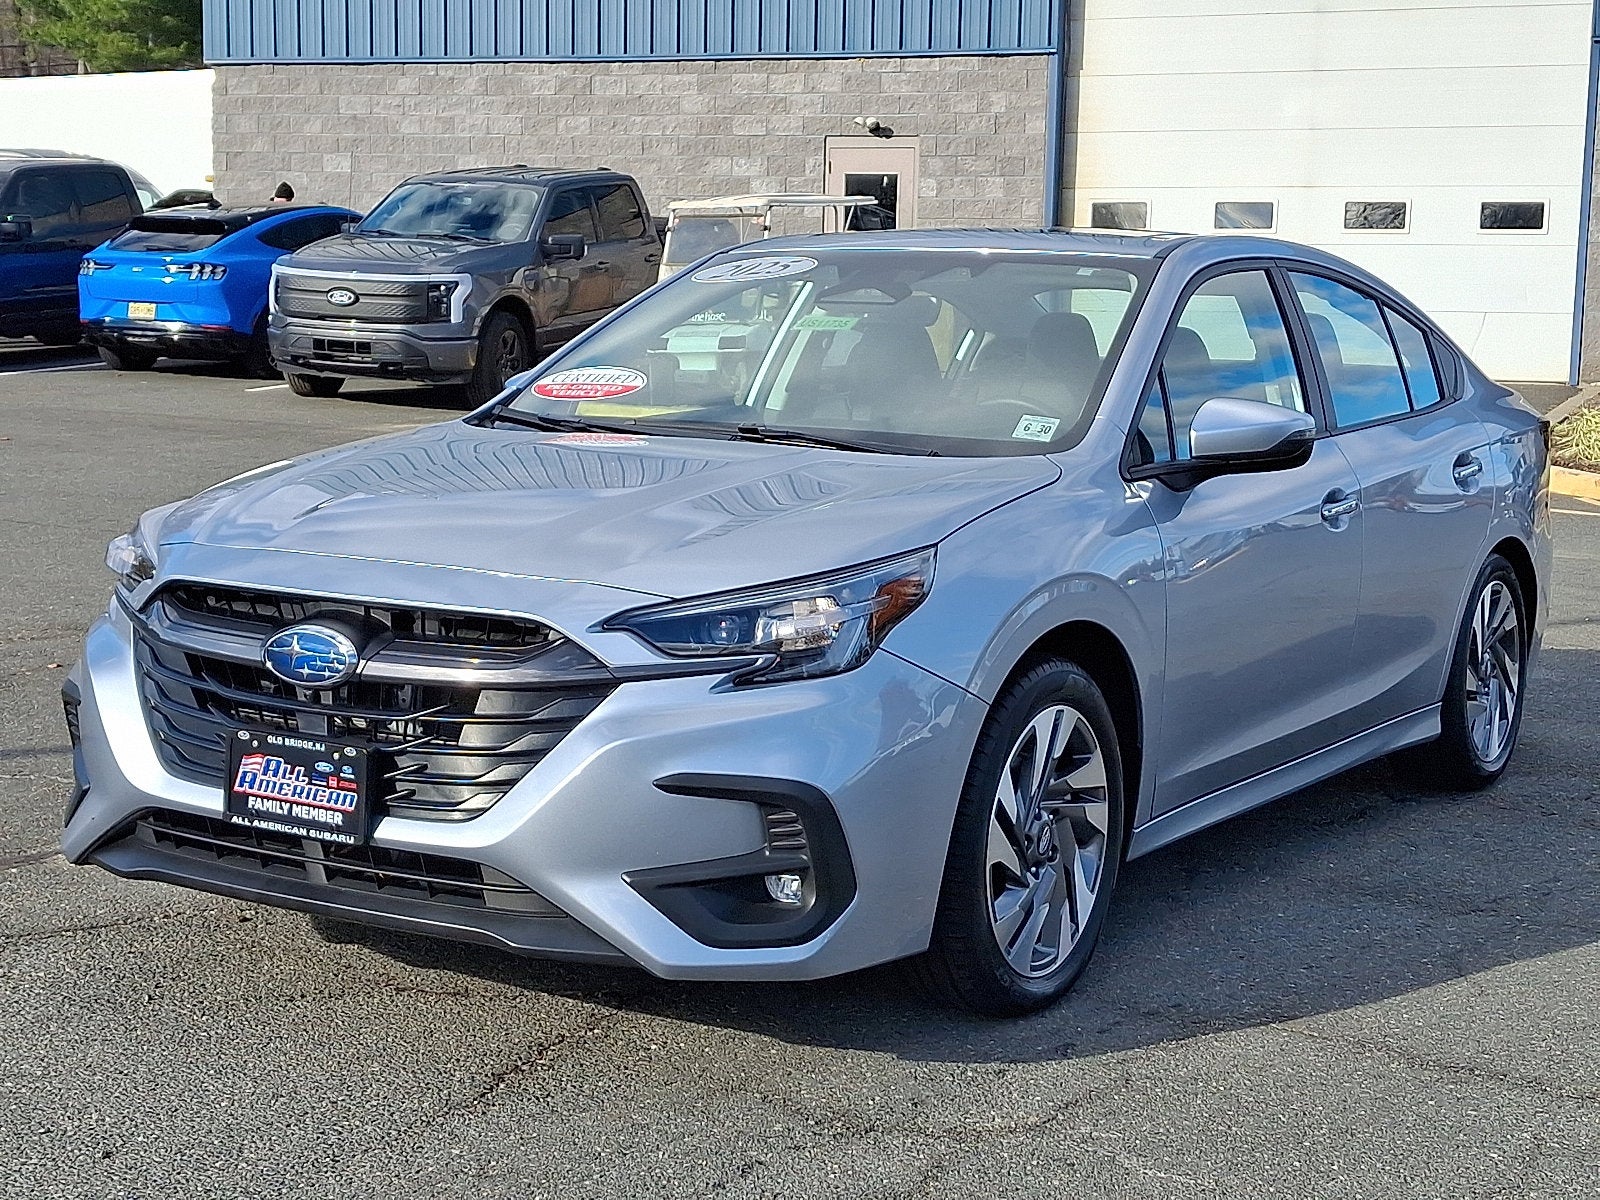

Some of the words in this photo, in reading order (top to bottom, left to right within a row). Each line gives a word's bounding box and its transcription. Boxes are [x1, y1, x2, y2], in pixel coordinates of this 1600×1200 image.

[708, 260, 803, 278] 2025
[552, 373, 638, 383] CERTIFIED
[1023, 423, 1032, 431] 6
[1037, 425, 1052, 434] 30
[267, 735, 283, 745] OLD
[248, 796, 291, 814] FAMILY
[291, 805, 343, 826] MEMBER
[231, 815, 251, 827] ALL
[252, 819, 307, 837] AMERICAN
[308, 830, 355, 845] SUBARU
